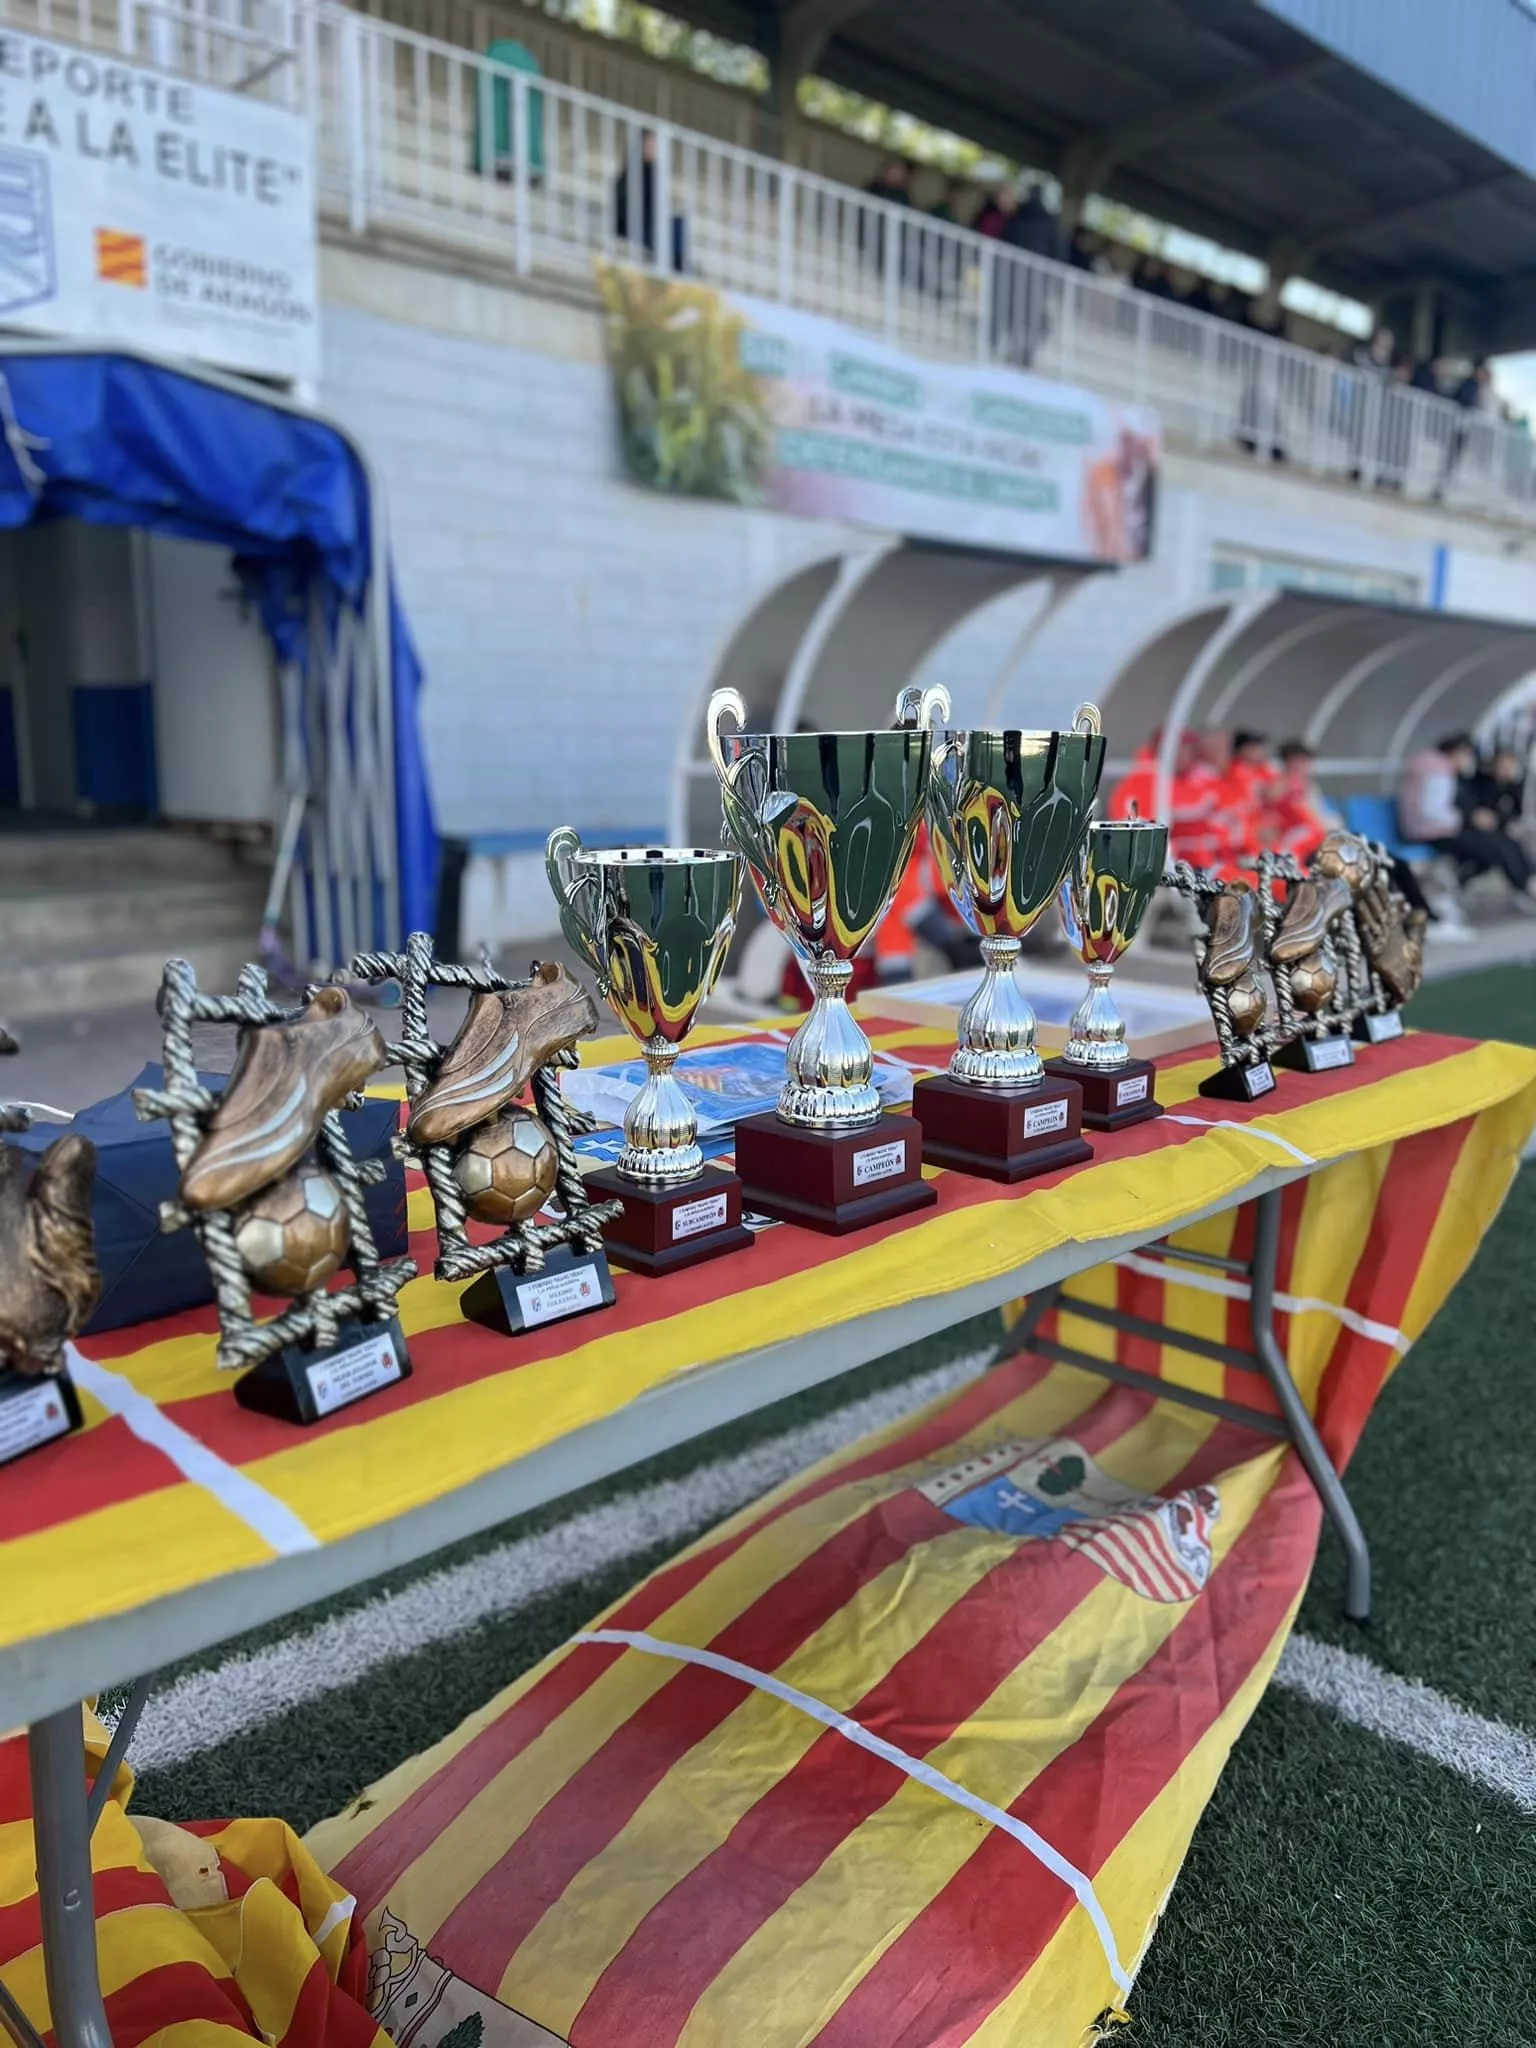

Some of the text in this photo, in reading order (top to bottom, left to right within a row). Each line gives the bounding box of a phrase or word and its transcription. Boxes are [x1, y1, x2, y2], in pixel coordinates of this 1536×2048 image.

[24, 97, 60, 147] A
[76, 109, 140, 168] LA
[864, 1158, 895, 1174] CAMPEÓN
